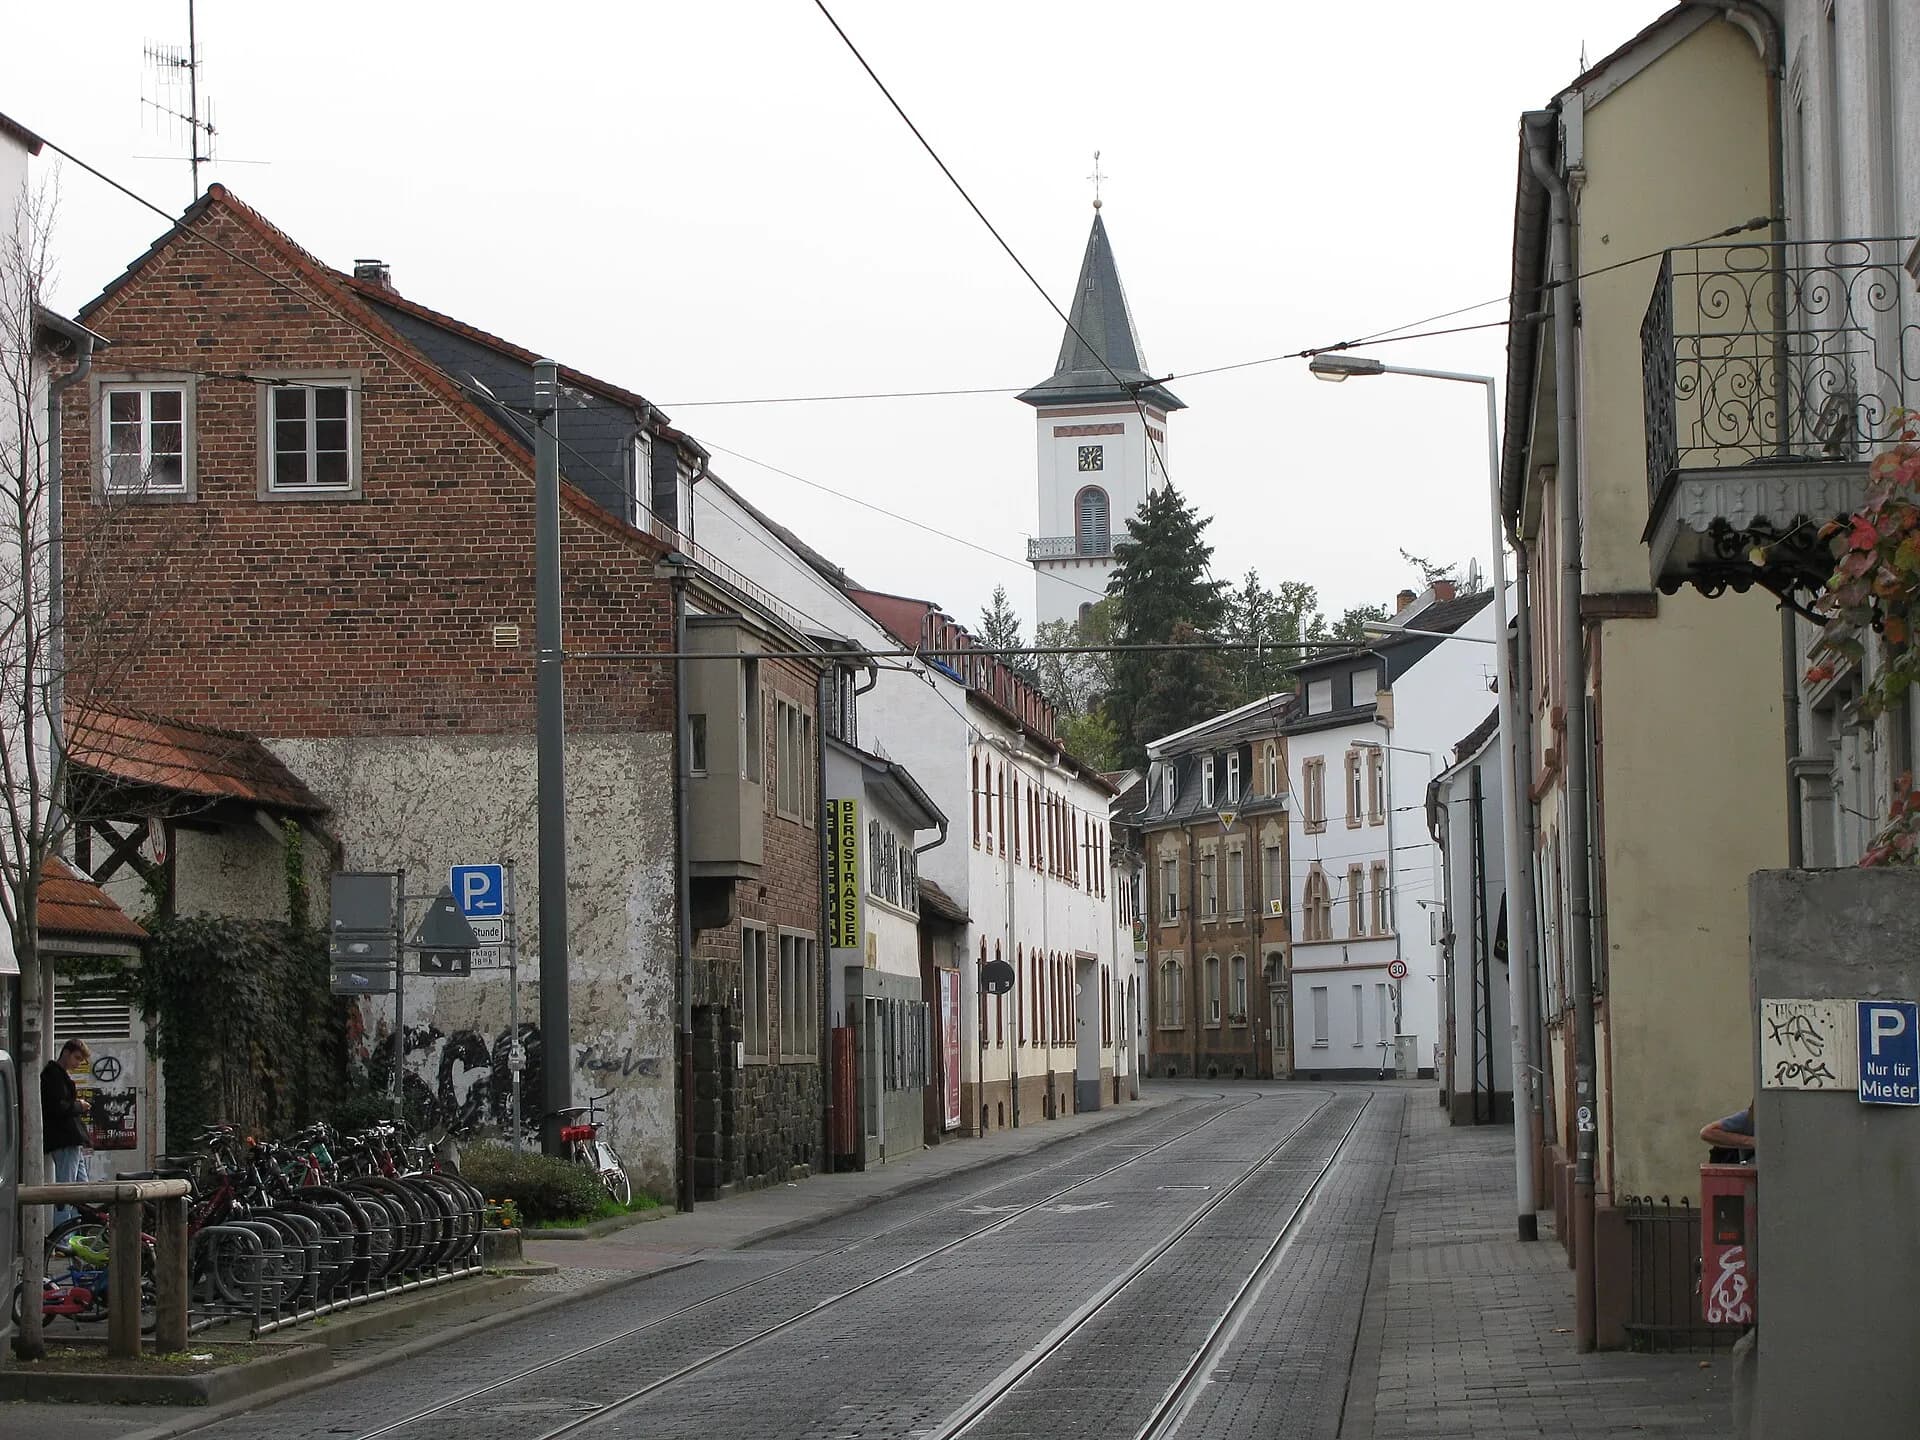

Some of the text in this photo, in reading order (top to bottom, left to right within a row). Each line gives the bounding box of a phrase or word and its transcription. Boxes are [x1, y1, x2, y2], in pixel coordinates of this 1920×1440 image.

[843, 802, 857, 945] BERGSTRÄSSER
[464, 872, 490, 910] P
[473, 927, 499, 937] Stunde
[1392, 965, 1403, 974] 30
[1870, 1008, 1905, 1056] P
[1867, 1061, 1911, 1076] Nur für
[1862, 1080, 1917, 1099] Mieter
